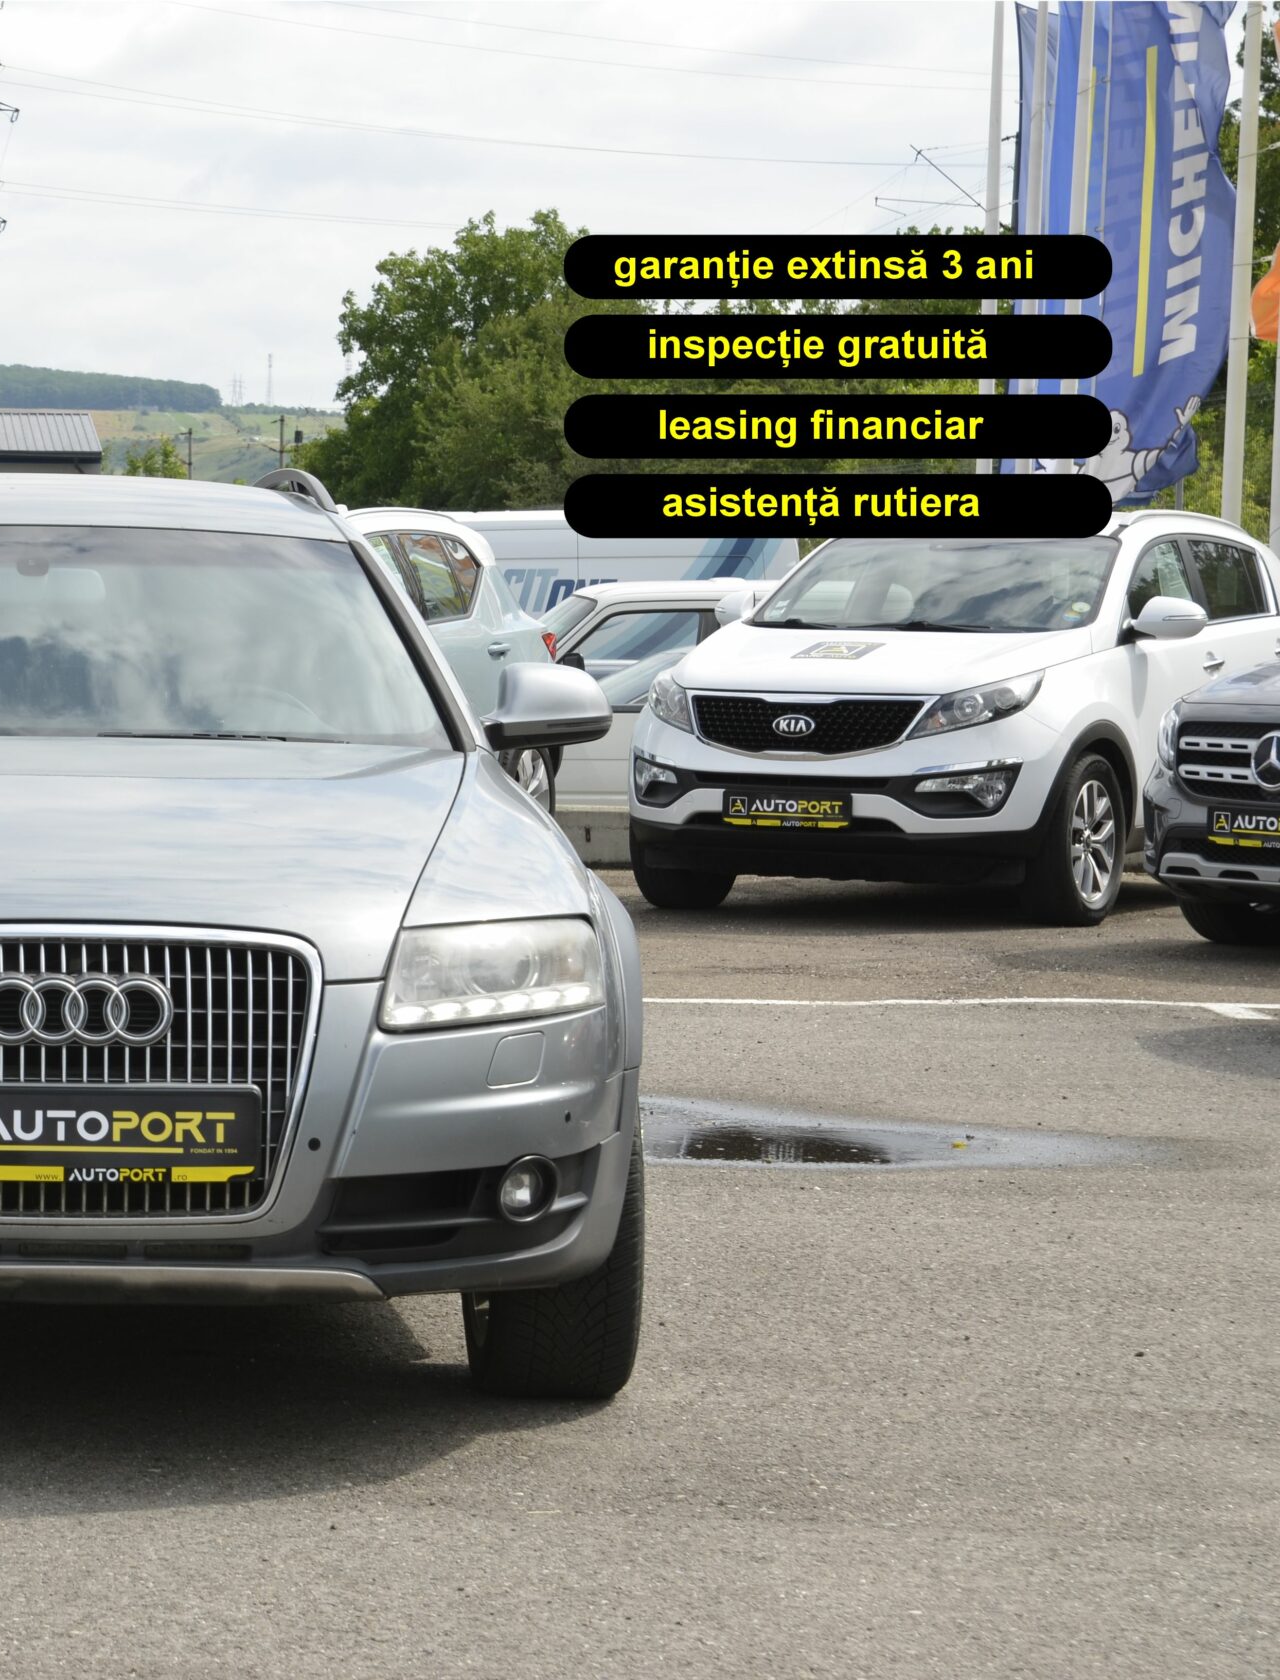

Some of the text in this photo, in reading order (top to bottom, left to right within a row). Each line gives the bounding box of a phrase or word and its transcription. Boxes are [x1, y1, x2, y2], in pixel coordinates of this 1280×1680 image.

[778, 718, 807, 732] KIA
[750, 799, 843, 815] AUTOPORT
[1233, 815, 1280, 831] AUTO
[34, 1173, 62, 1181] www.
[69, 1167, 167, 1182] AUTOPORT
